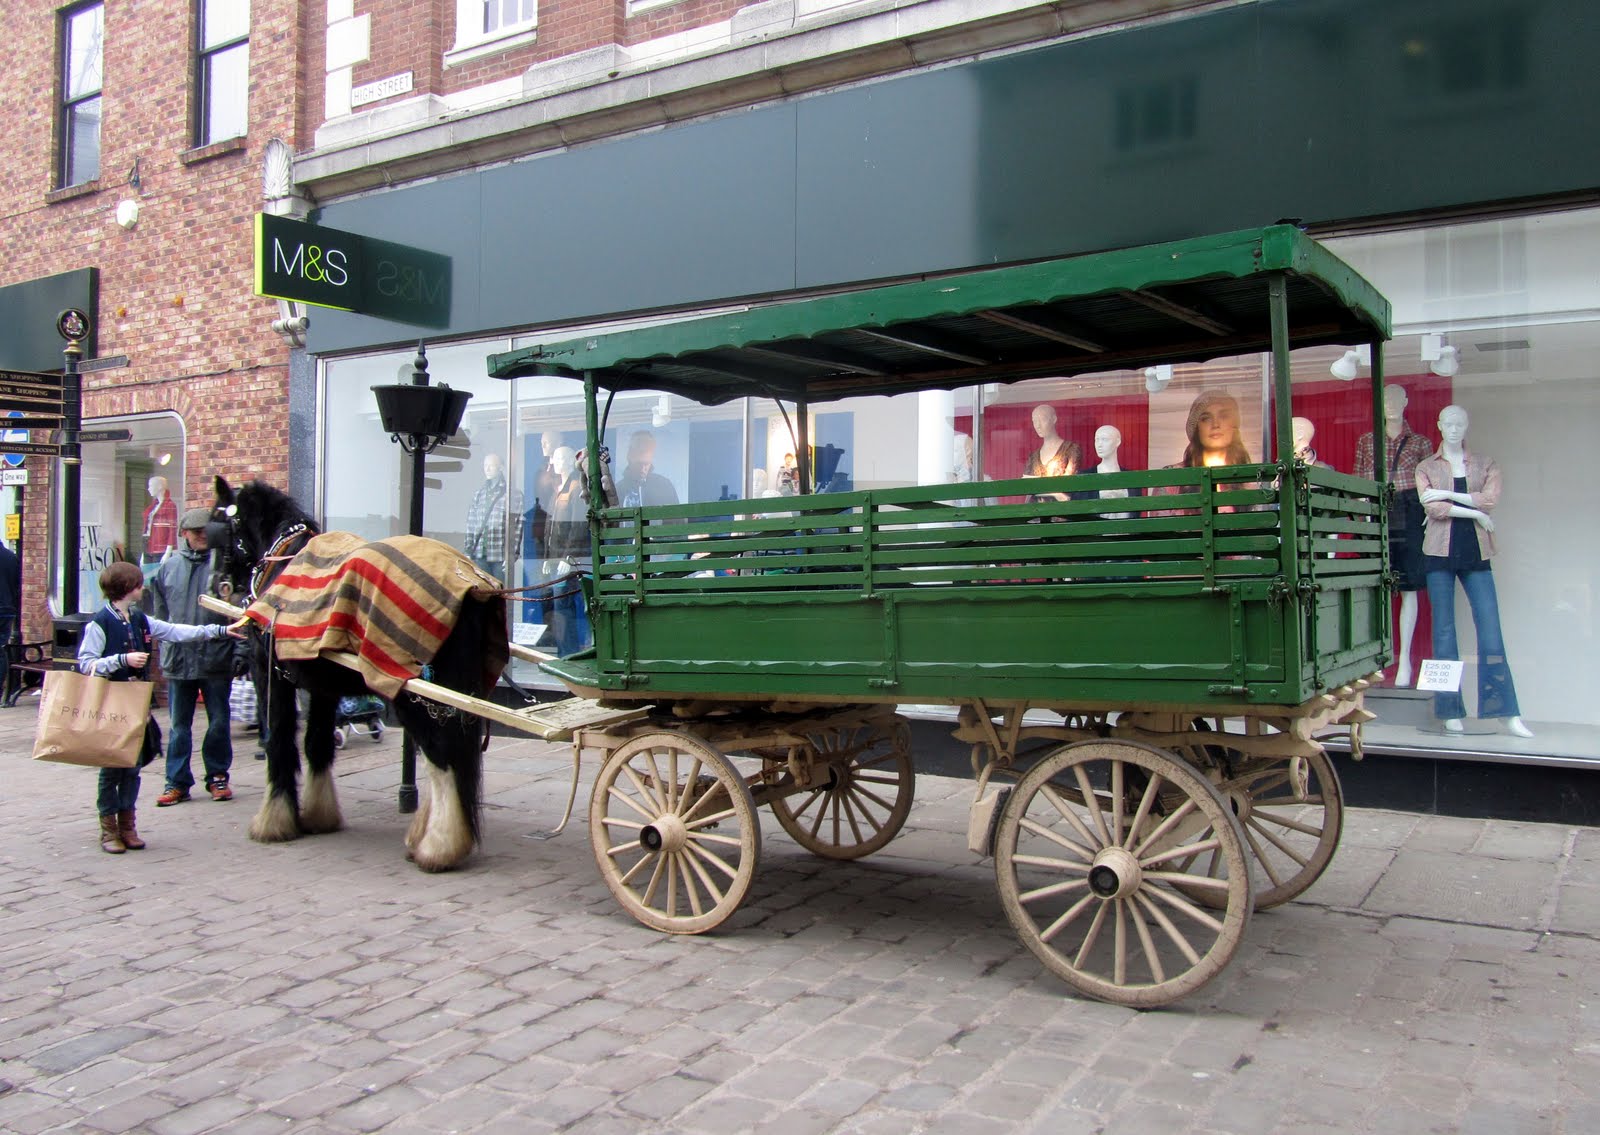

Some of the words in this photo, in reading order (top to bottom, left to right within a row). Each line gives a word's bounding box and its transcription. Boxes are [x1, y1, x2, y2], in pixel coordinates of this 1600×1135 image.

[353, 86, 374, 103] HIGH
[377, 75, 410, 97] STREET
[274, 237, 348, 286] M&S
[16, 388, 48, 397] SHOPPING
[4, 473, 15, 481] One
[80, 525, 102, 549] EW
[61, 705, 129, 723] PRIMARK
